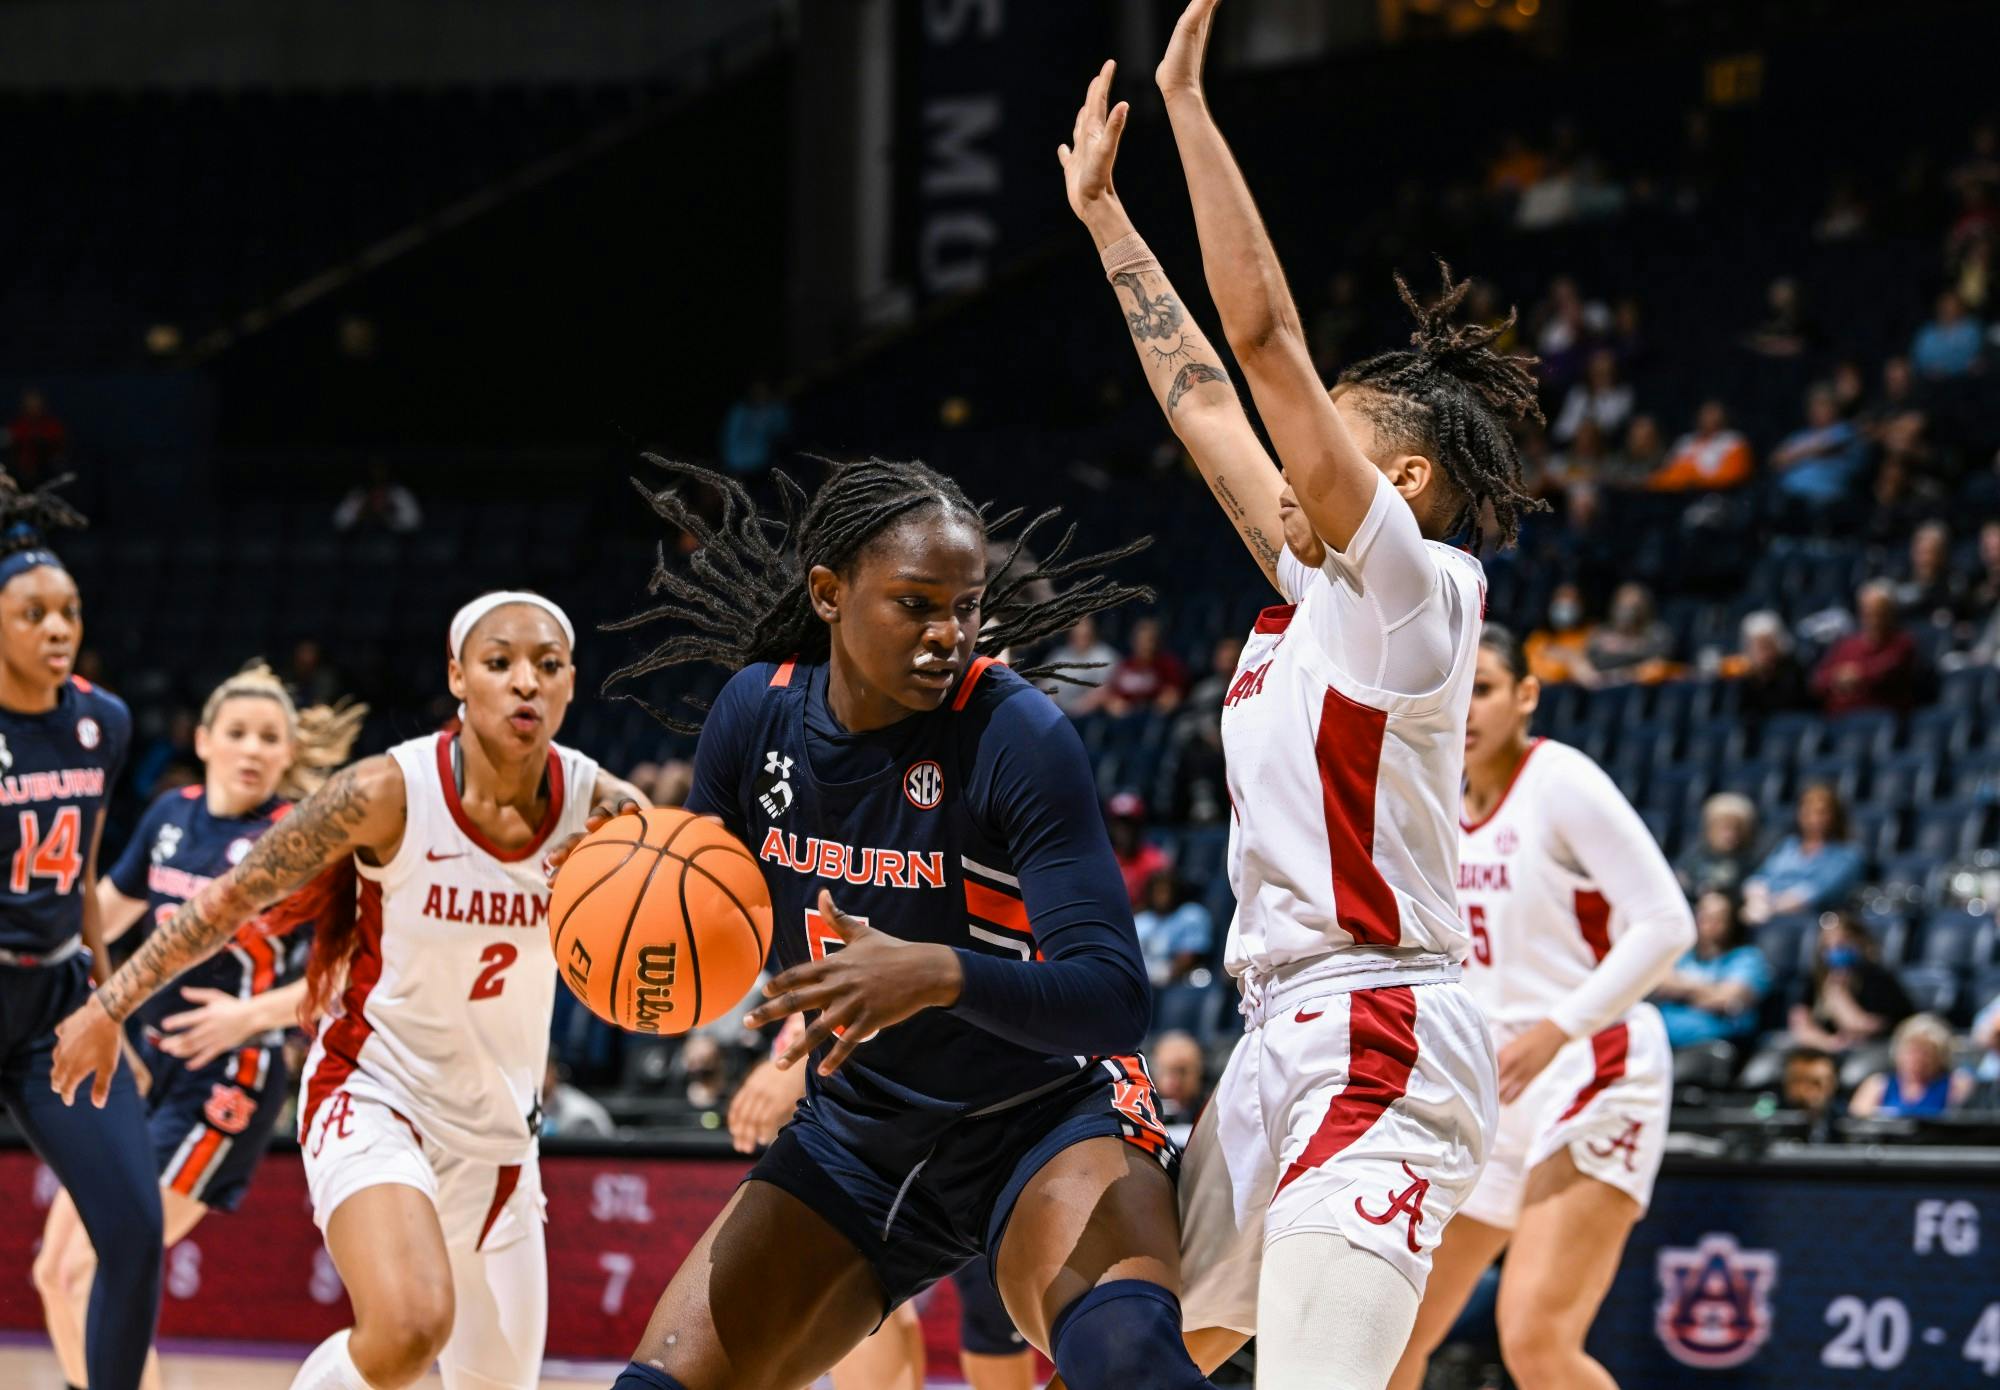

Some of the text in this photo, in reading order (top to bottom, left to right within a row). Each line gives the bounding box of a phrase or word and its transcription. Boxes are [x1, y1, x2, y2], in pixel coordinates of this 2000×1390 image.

[909, 764, 941, 805] SEC
[10, 805, 83, 896] 14
[759, 826, 947, 889] AUBURN
[422, 883, 552, 928] ALABAM
[1458, 904, 1492, 969] 5
[468, 942, 528, 1002] 2
[568, 937, 592, 1006] EV
[635, 942, 677, 1034] Wilso
[590, 1172, 653, 1224] STL
[1354, 1159, 1430, 1254] A
[1914, 1199, 1980, 1256] FG
[598, 1252, 635, 1315] 7
[1821, 1295, 1912, 1370] 20
